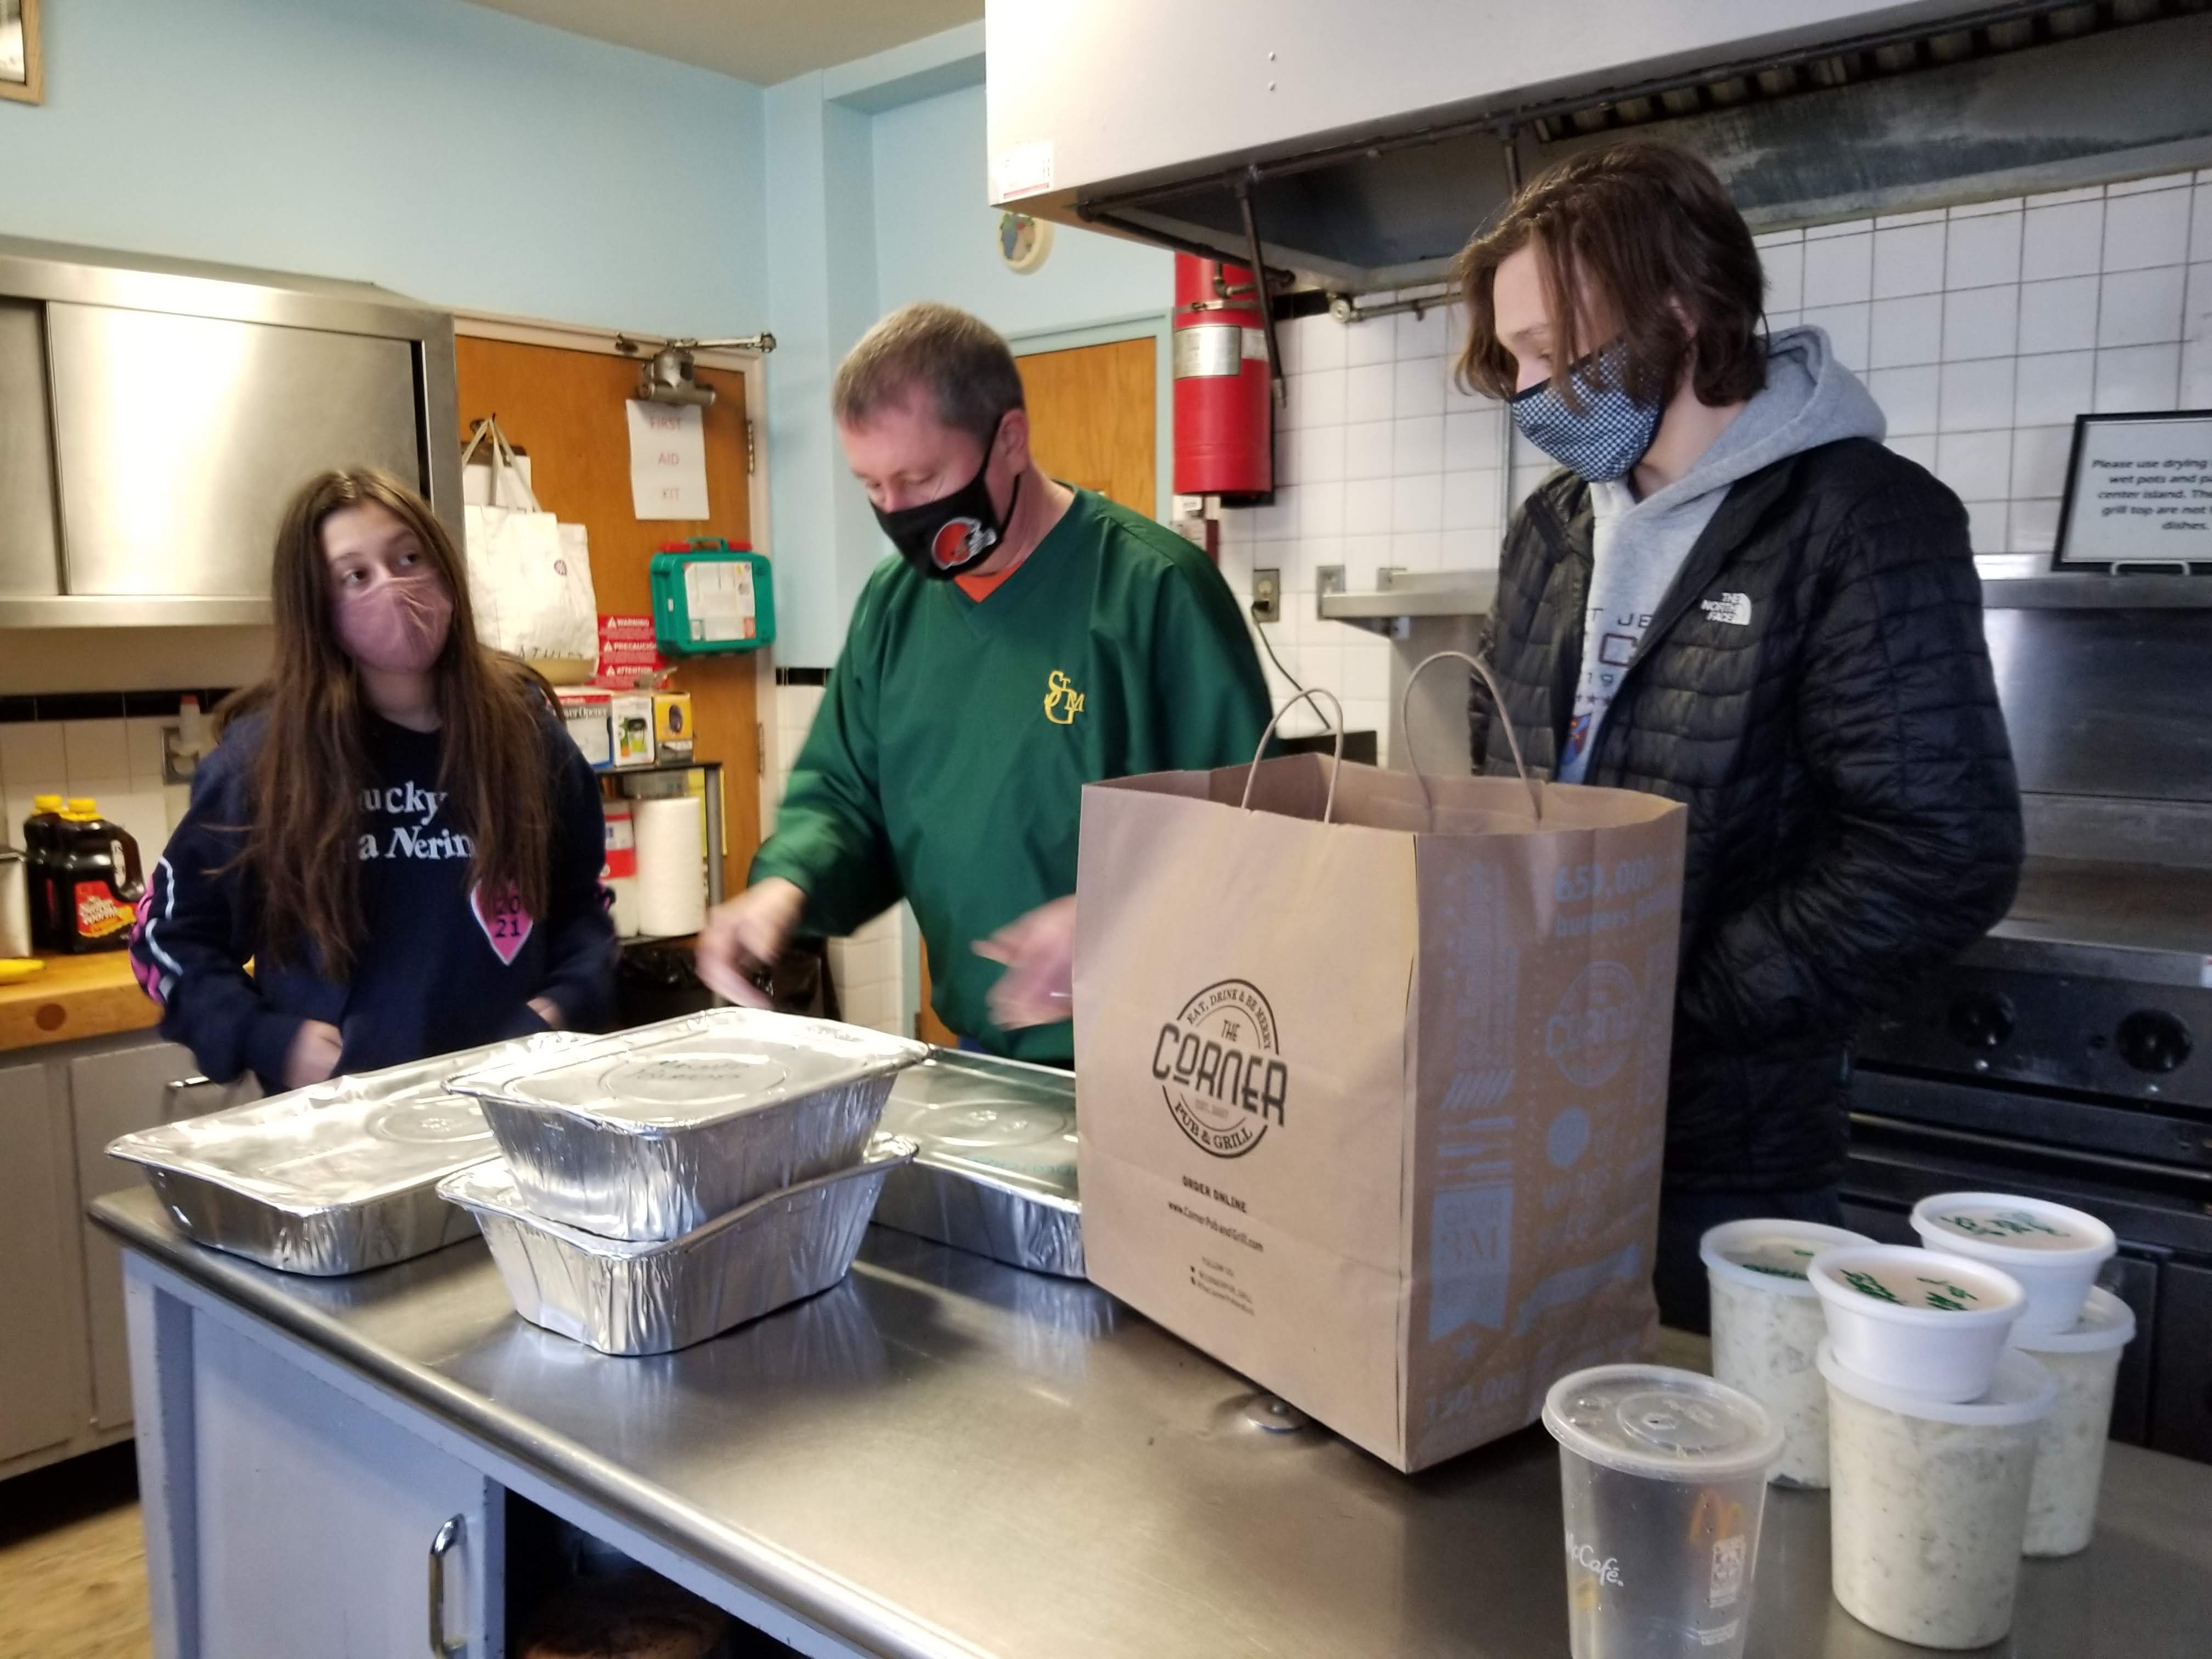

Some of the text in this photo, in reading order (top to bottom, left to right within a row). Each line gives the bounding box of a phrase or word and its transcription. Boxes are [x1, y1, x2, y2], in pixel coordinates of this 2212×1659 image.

[650, 416, 682, 431] FIRST
[659, 452, 680, 466] AID
[2092, 459, 2134, 468] Please
[2163, 459, 2208, 471] drying
[2169, 475, 2197, 483] and
[661, 487, 680, 500] KIT
[2142, 490, 2187, 499] island.
[2101, 505, 2128, 518] grill
[2130, 506, 2153, 517] top
[1722, 592, 1739, 603] THE
[1701, 599, 1738, 613] NORTH
[617, 618, 650, 627] WARNING
[1707, 611, 1734, 624] FACE
[495, 919, 521, 938] 21
[1186, 988, 1272, 1050] EAT, DRINK & BE MERRY
[1221, 1019, 1241, 1042] THE
[1152, 1022, 1288, 1128] CORNER
[1175, 1101, 1253, 1151] PUB & GRILL
[1182, 1175, 1247, 1214] ORDER ONLINE
